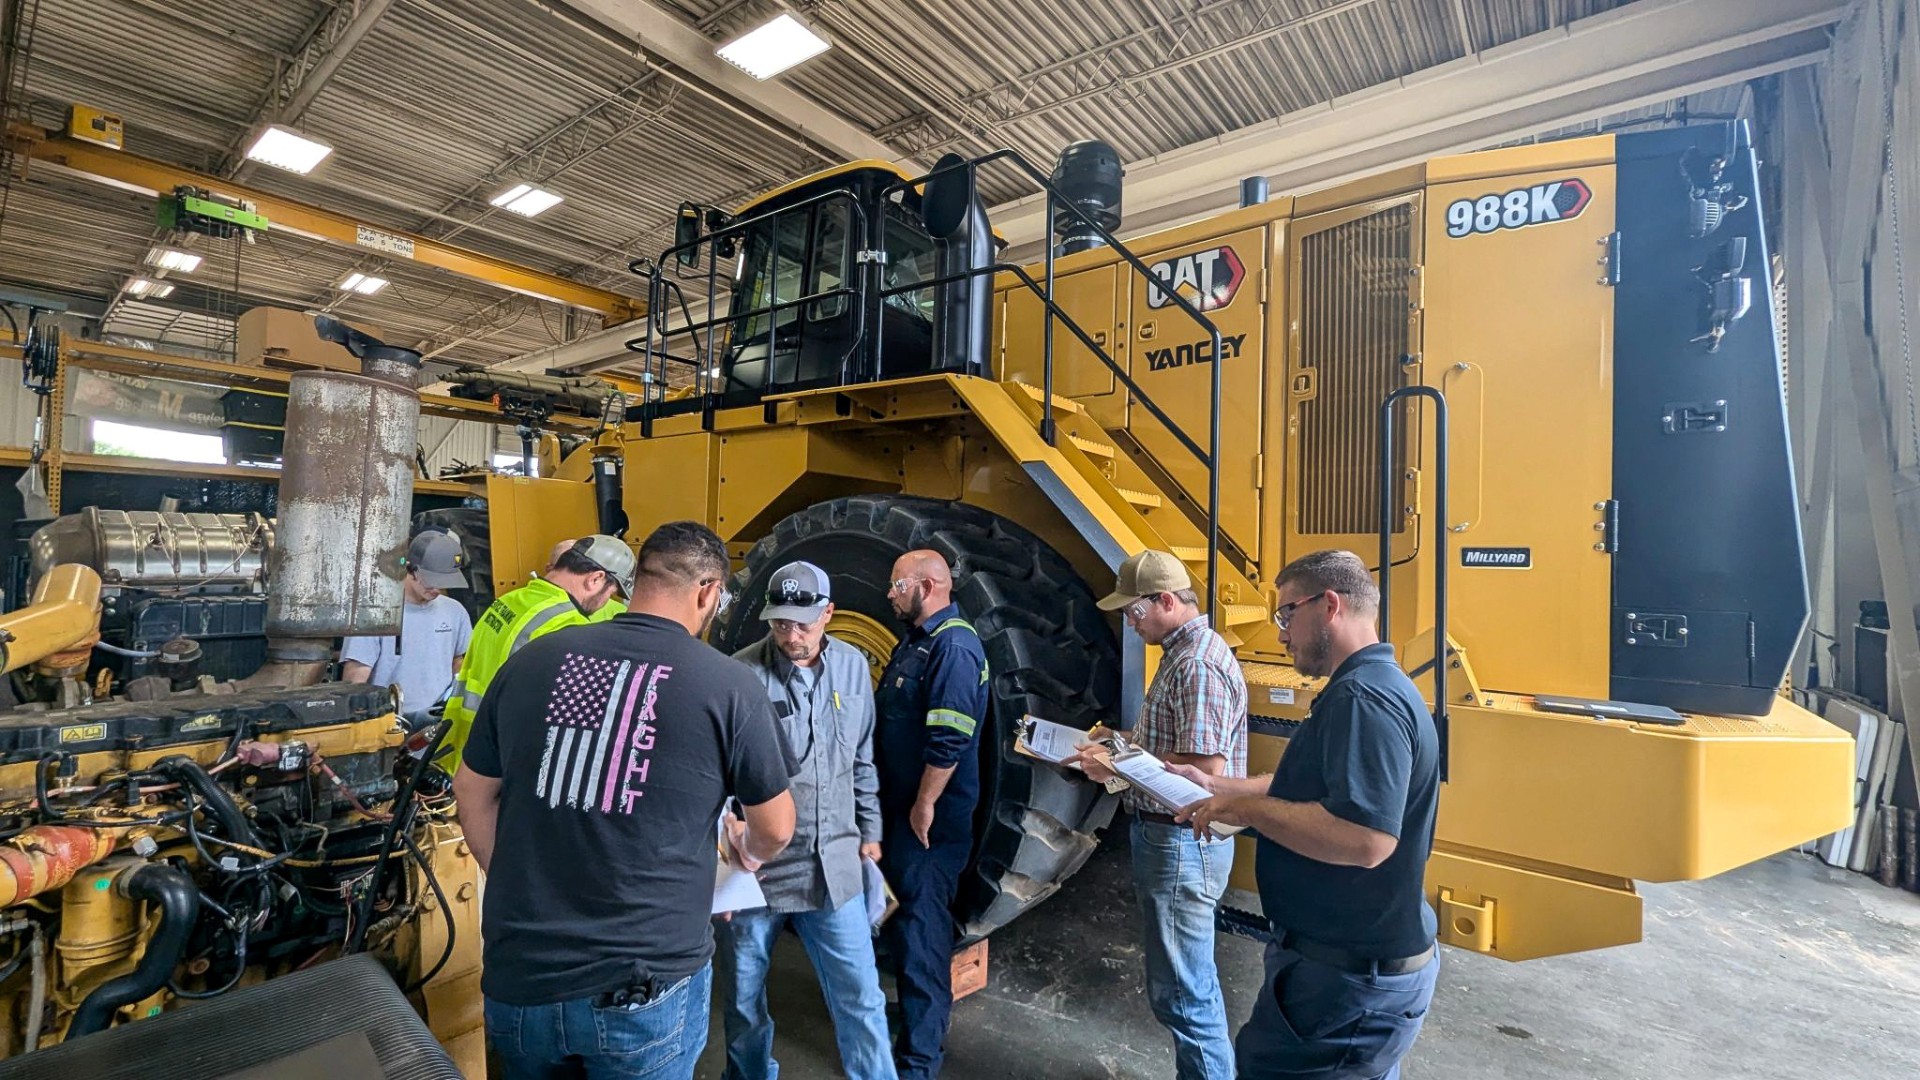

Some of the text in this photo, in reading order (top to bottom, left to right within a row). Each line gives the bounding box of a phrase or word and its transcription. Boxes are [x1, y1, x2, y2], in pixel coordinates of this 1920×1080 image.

[1448, 182, 1562, 237] 988K
[393, 243, 414, 253] TONS
[1148, 248, 1220, 308] CAT
[1144, 333, 1247, 371] YANCEY
[1465, 551, 1526, 563] MILLYARD
